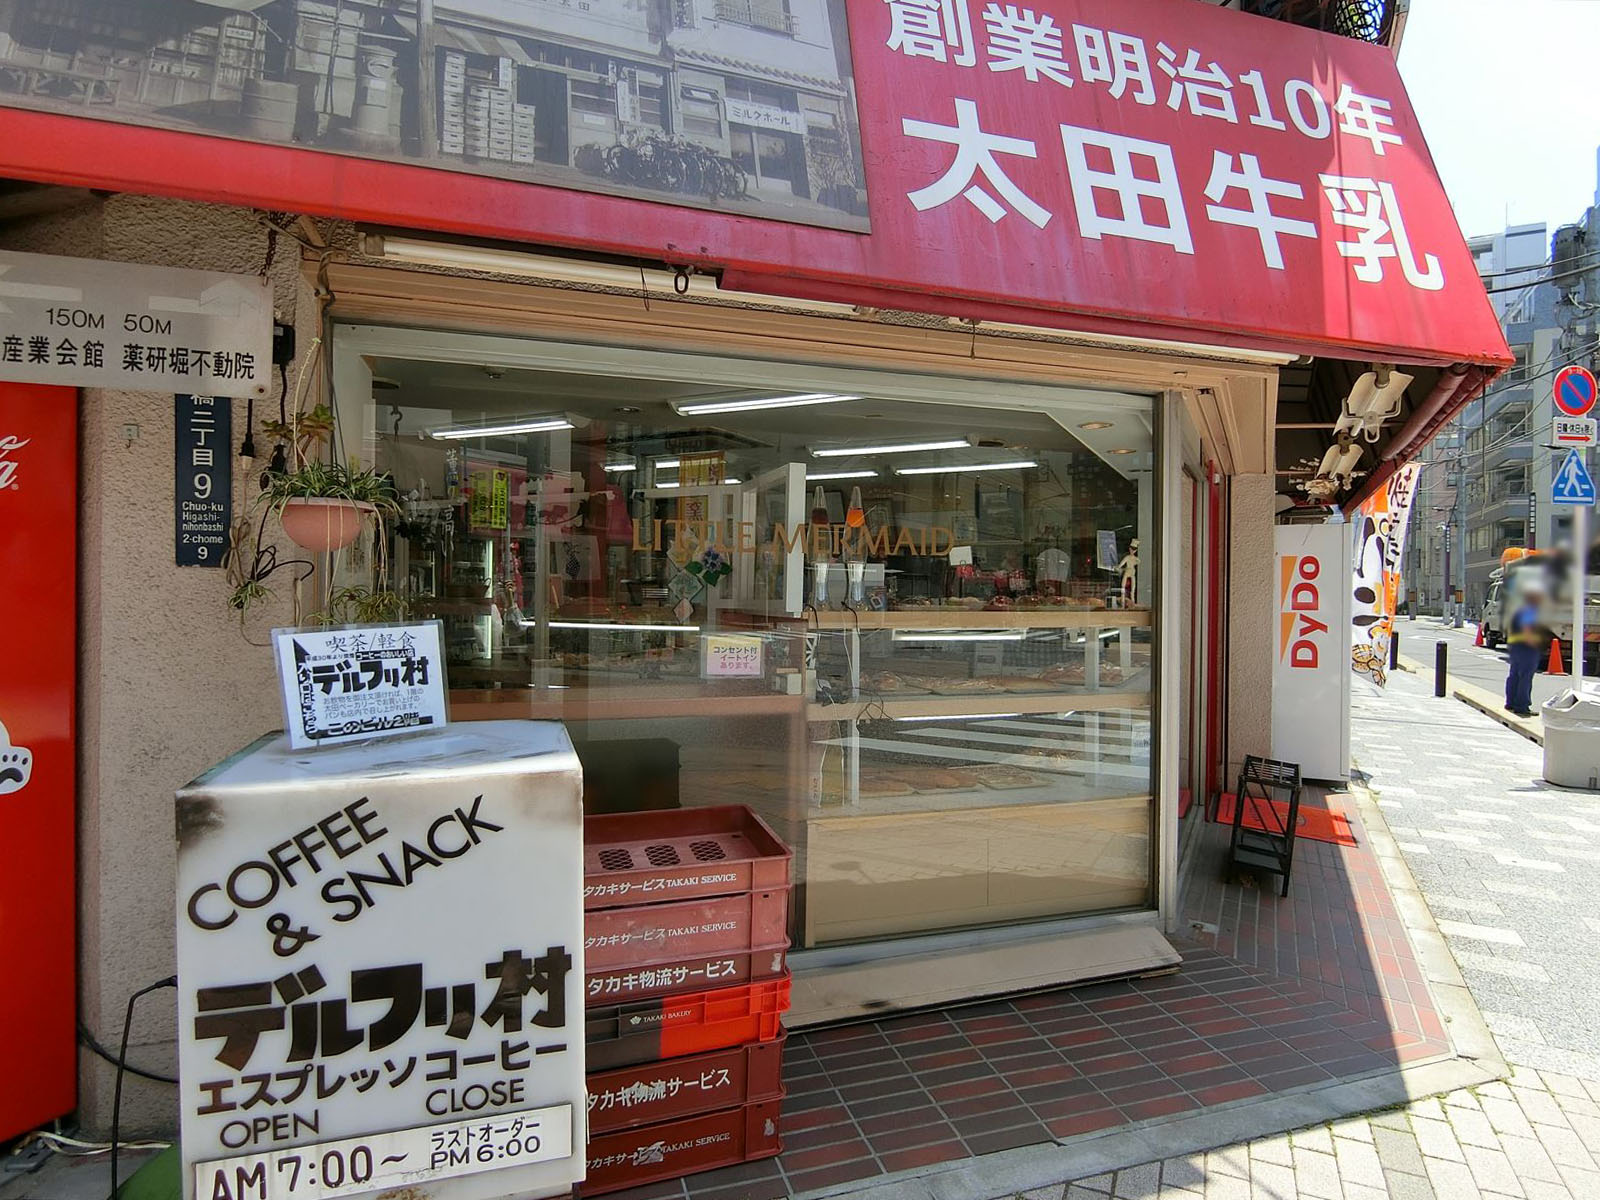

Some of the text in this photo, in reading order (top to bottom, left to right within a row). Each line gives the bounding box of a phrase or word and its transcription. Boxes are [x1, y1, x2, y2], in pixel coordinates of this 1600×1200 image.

[885, 0, 1403, 156] 創業明治10年
[732, 108, 791, 126] ミルクホール
[902, 98, 1445, 292] 太田牛乳
[46, 308, 171, 335] 150M 50M
[2, 334, 255, 379] 産業会館 薬研堀不動院
[182, 501, 224, 512] Chuo-ku
[182, 511, 221, 523] Higashi-
[182, 522, 224, 532] nihonbashi
[182, 533, 224, 544] 2-chome
[632, 518, 955, 557] LITTLE MERMAID
[197, 546, 209, 560] 9
[1290, 555, 1328, 668] DyDo
[713, 646, 757, 654] コンセント付
[720, 654, 757, 662] イートイン
[312, 656, 429, 695] デルフリ村
[327, 712, 420, 735] このビル2階
[187, 796, 388, 931] COFFEE
[266, 794, 504, 957] & SNACK
[584, 873, 737, 898] タカキサービス TAKAKI SERVICE
[585, 921, 737, 949] タカキサービス TAKAKI SERVICE
[588, 959, 737, 996] タカキ物流サービス
[195, 946, 572, 1071] デルフリ村
[643, 1009, 692, 1023] TAKAKI BAKERY
[426, 1078, 525, 1116] CLOSE
[219, 1109, 320, 1149] OPEN
[431, 1117, 541, 1151] ラストオーダー
[661, 1141, 693, 1154] TAKAKI
[695, 1132, 730, 1146] SERVICE
[430, 1136, 541, 1170] PM 6:00
[212, 1161, 267, 1200] AM
